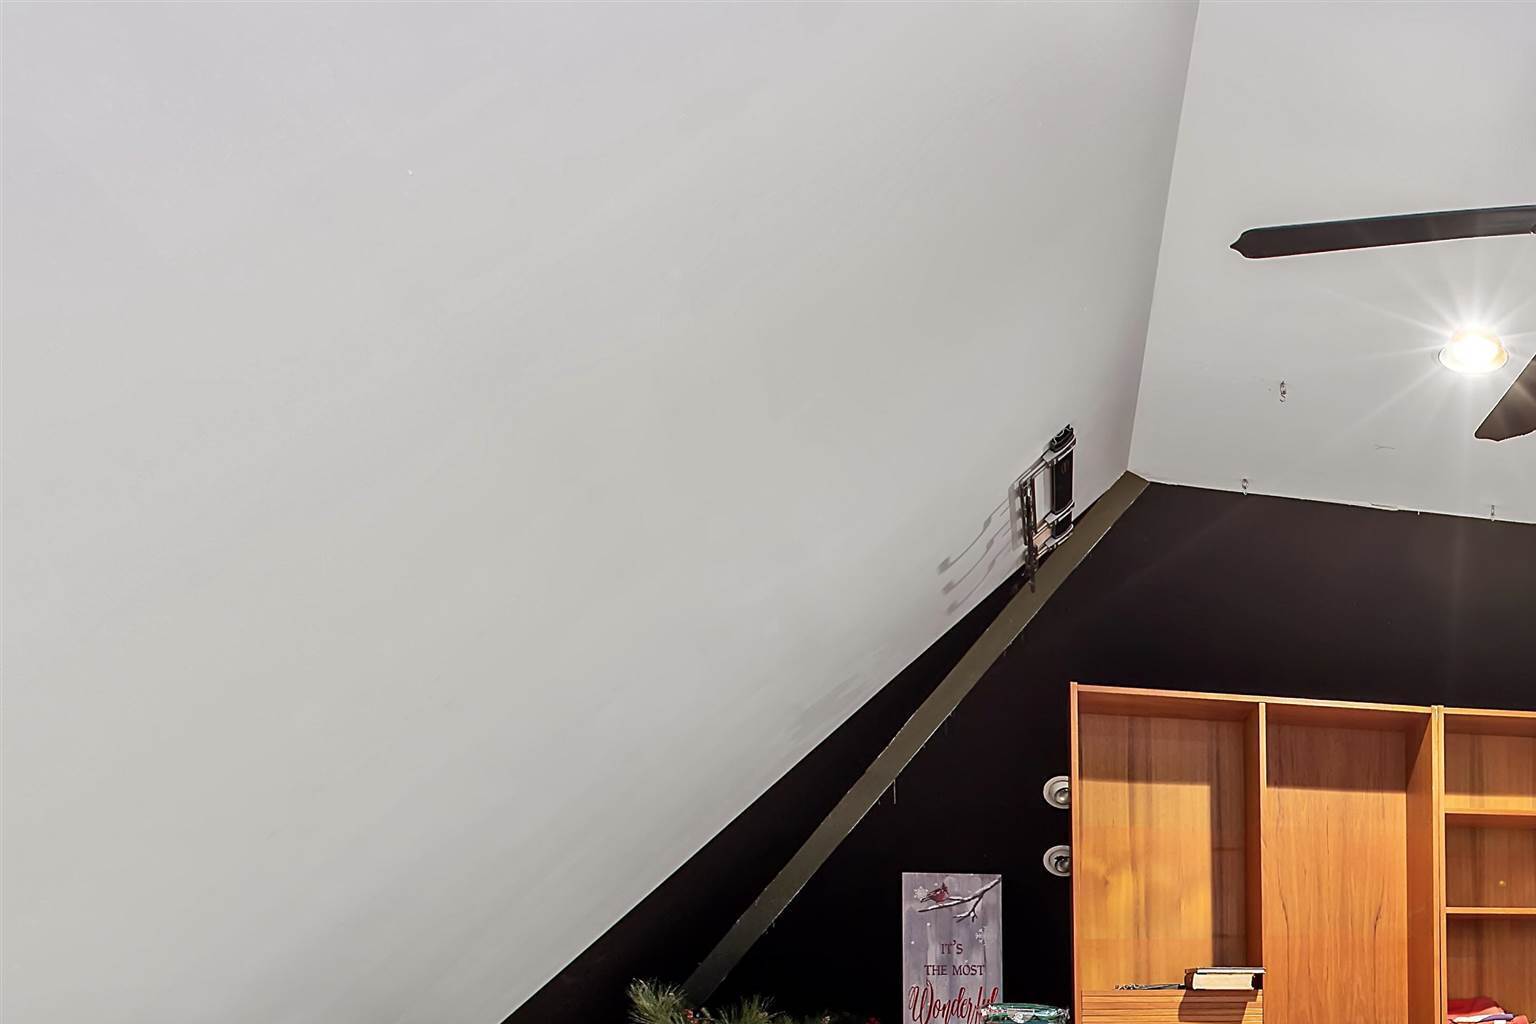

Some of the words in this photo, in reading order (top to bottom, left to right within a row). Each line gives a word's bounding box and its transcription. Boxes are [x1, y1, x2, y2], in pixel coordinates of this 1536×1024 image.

[941, 940, 963, 954] IT'S
[924, 964, 947, 976] THE
[952, 964, 985, 976] MOST
